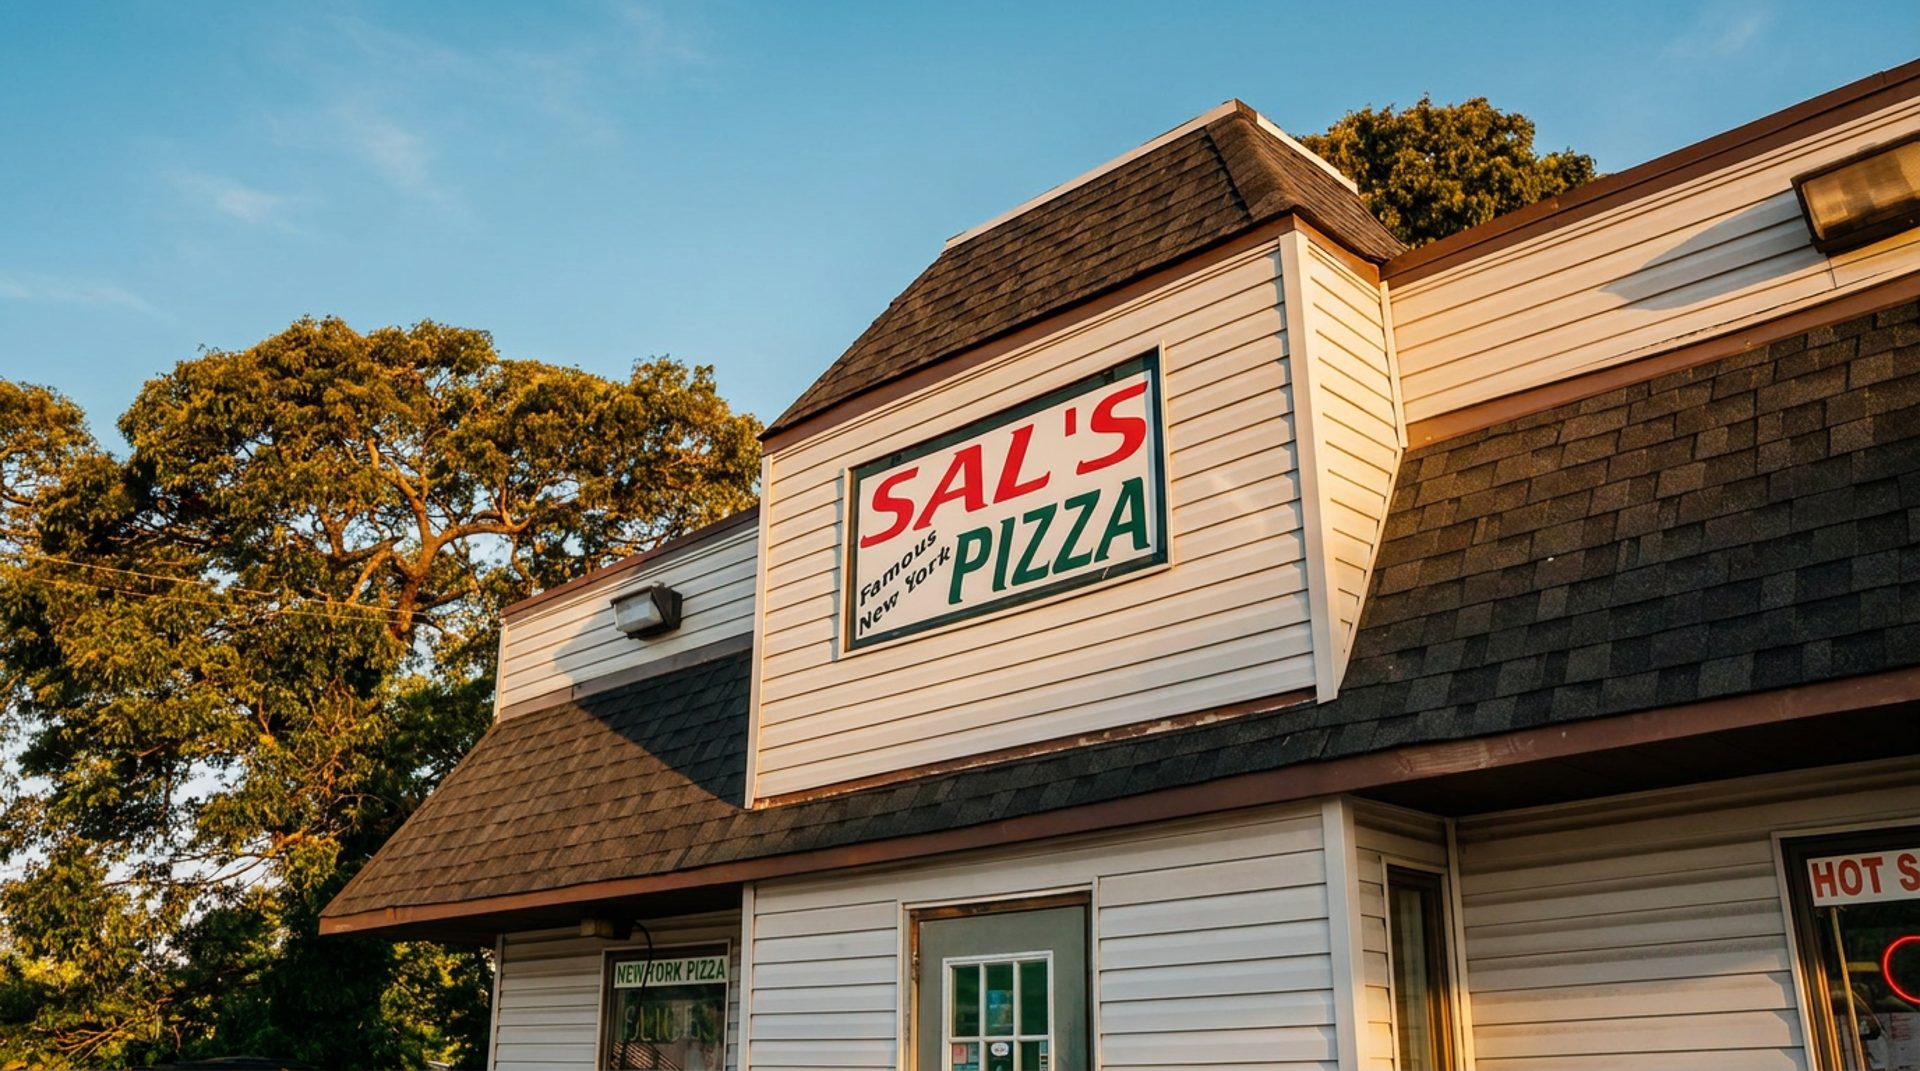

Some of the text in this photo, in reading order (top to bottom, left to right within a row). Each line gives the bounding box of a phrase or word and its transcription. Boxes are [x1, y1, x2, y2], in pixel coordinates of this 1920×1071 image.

[860, 381, 1149, 549] SAL'S
[860, 529, 937, 607] Famous
[948, 476, 1151, 605] PIZZA
[859, 545, 951, 636] New York
[1811, 856, 1884, 899] HOT
[617, 963, 645, 984] NEW
[686, 958, 726, 981] PIZZA
